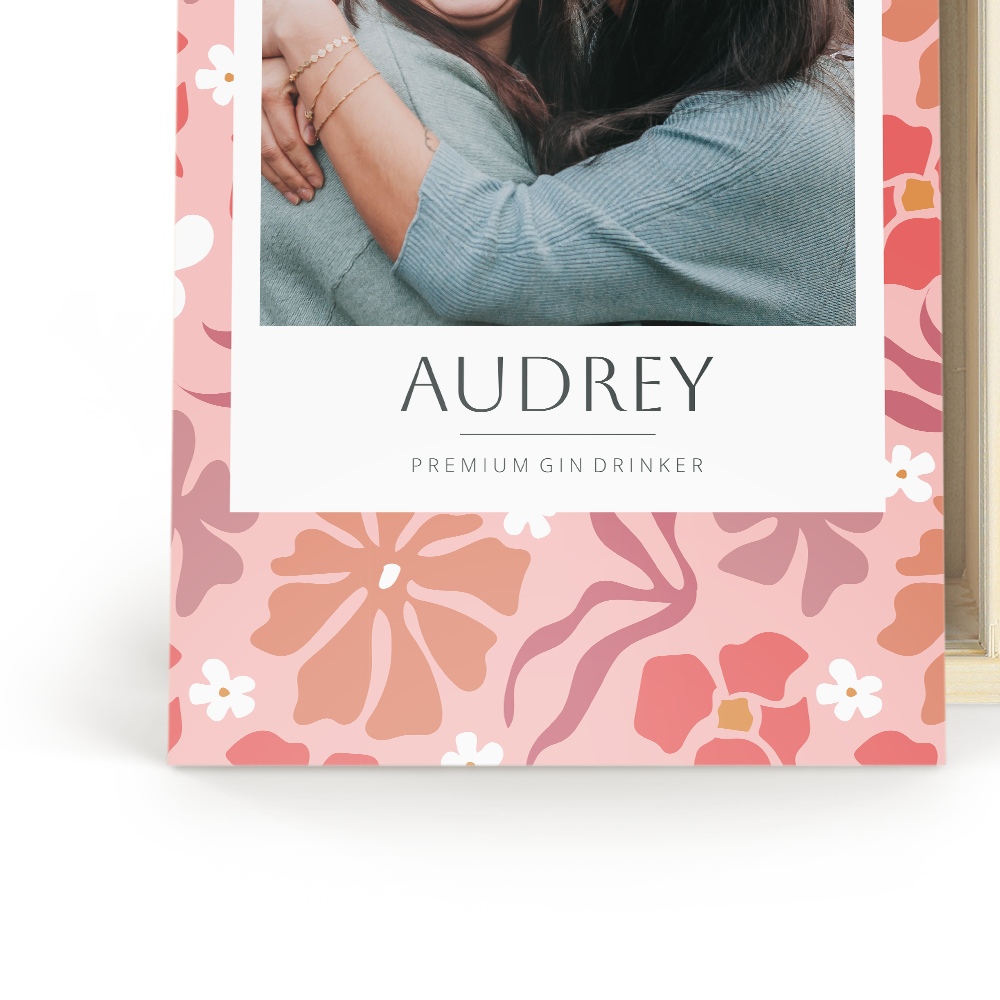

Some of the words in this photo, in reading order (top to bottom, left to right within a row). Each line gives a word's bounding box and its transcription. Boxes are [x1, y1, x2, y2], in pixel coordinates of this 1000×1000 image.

[400, 356, 714, 413] AUDREY
[411, 457, 529, 473] PREMIUM
[539, 457, 583, 473] GIN
[594, 457, 704, 473] DRINKER
